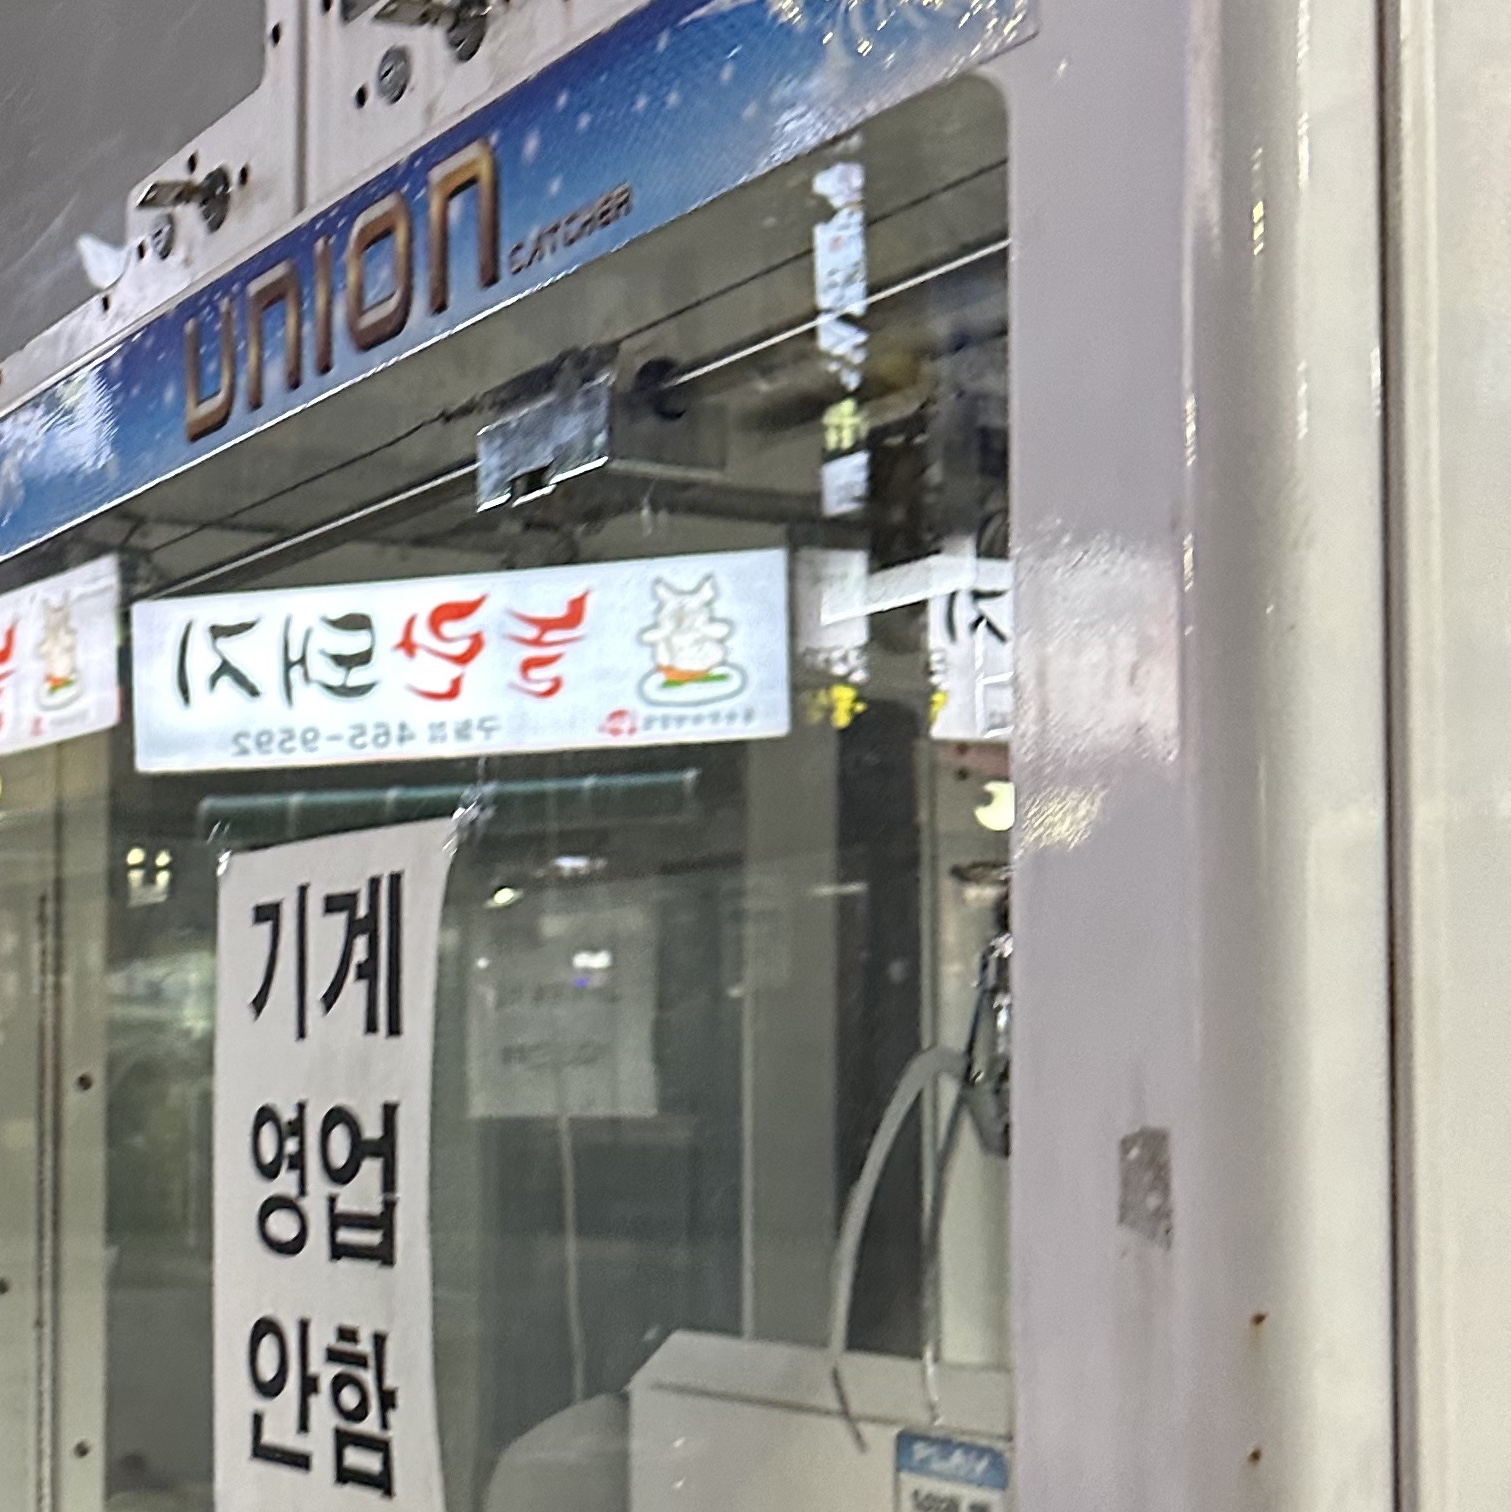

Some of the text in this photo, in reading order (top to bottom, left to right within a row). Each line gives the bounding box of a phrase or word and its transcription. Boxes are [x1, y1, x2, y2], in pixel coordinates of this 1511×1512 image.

[508, 182, 632, 275] CATCHER
[249, 870, 406, 1041] 기계
[252, 1100, 398, 1268] 영업
[249, 1313, 397, 1498] 안함
